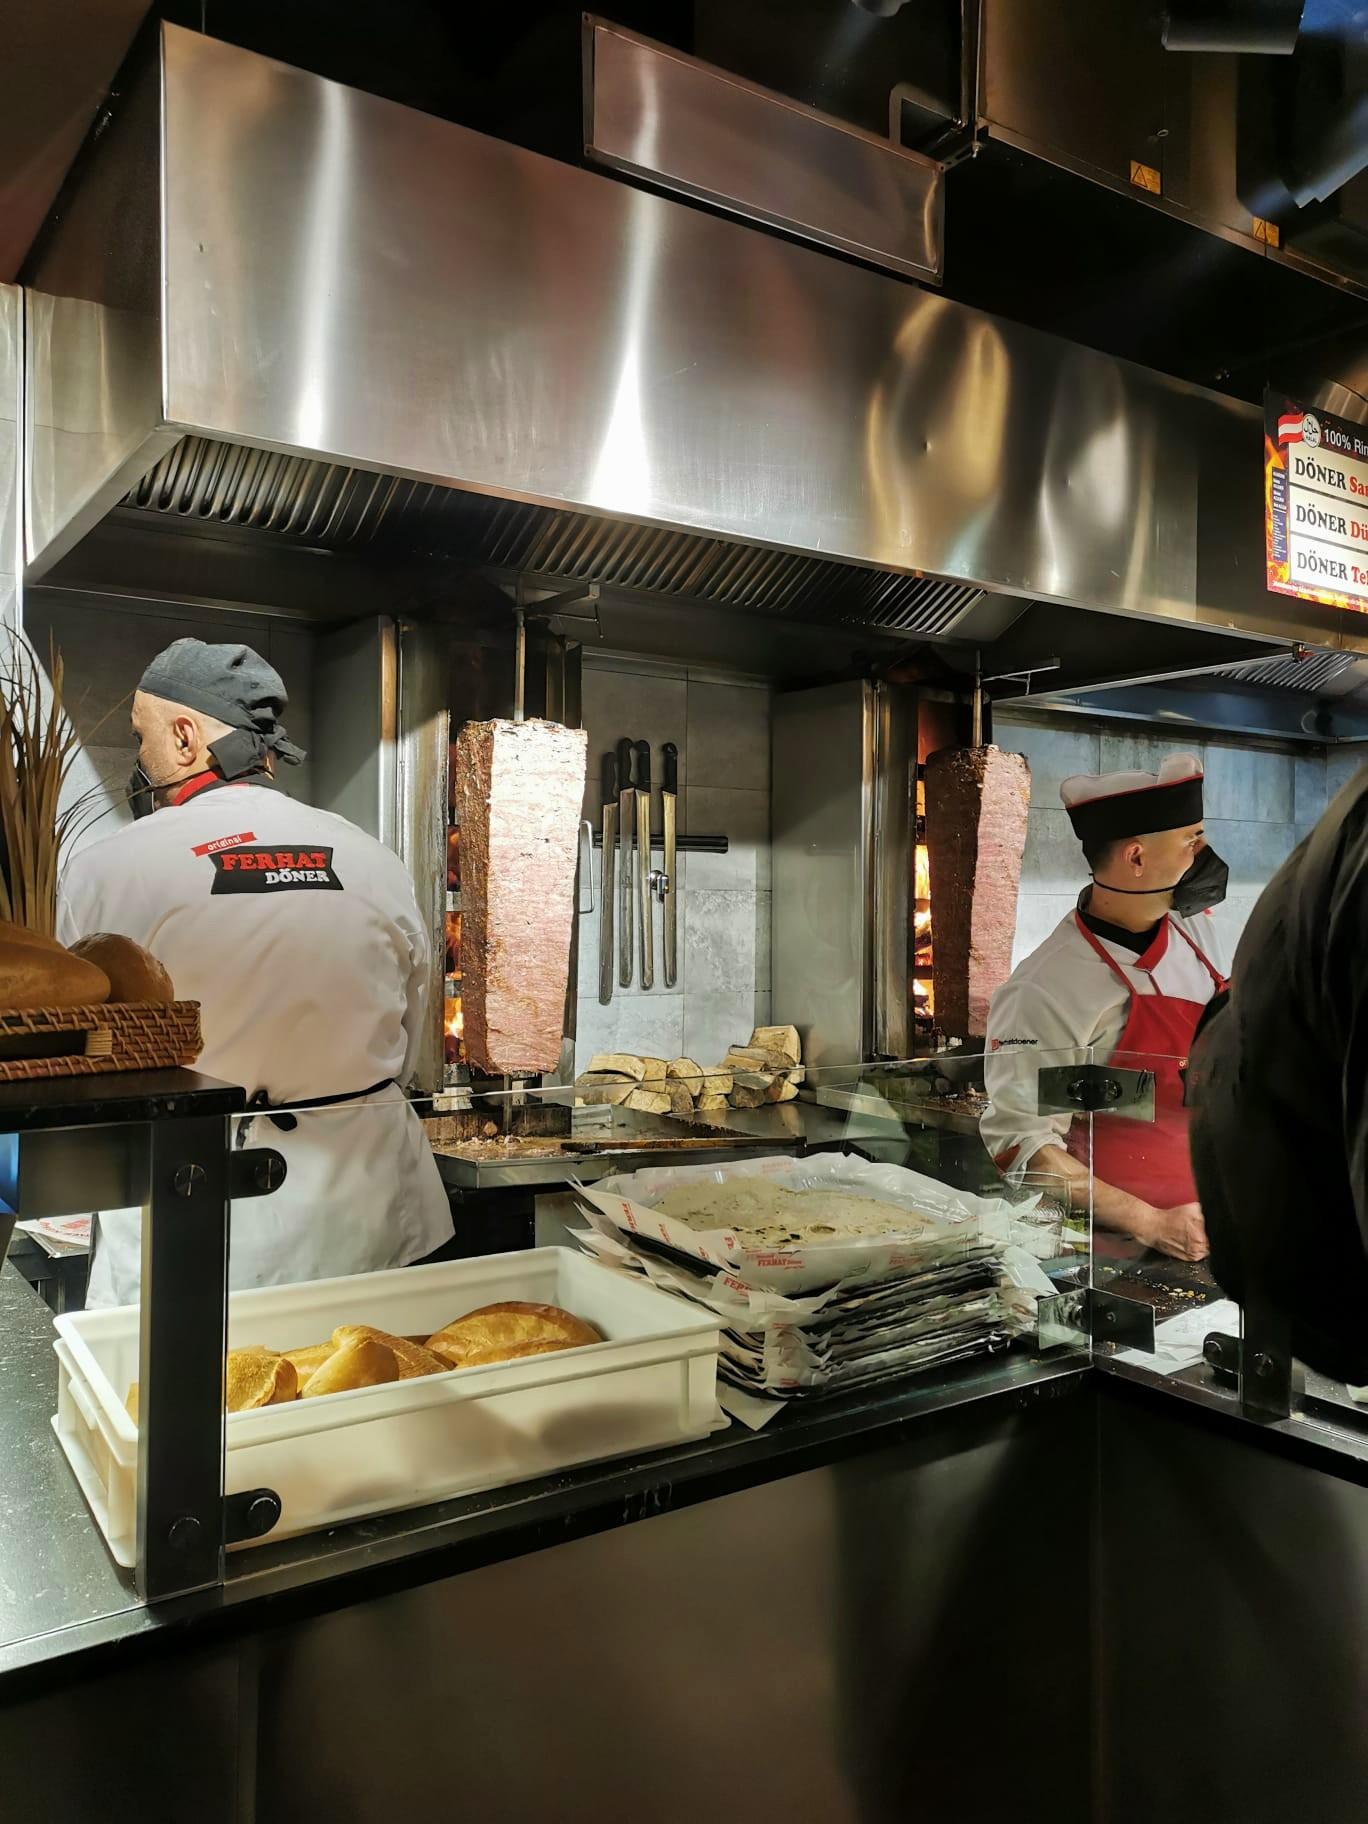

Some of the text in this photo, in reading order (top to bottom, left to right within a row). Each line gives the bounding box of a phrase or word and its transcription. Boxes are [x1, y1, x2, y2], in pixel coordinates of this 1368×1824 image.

[1324, 428, 1351, 450] 100%
[1295, 456, 1346, 490] DÖNER
[1296, 503, 1347, 536] DÖNER
[1297, 549, 1348, 581] DÖNER
[220, 852, 327, 870] FERHAT
[265, 868, 330, 884] DÖNER
